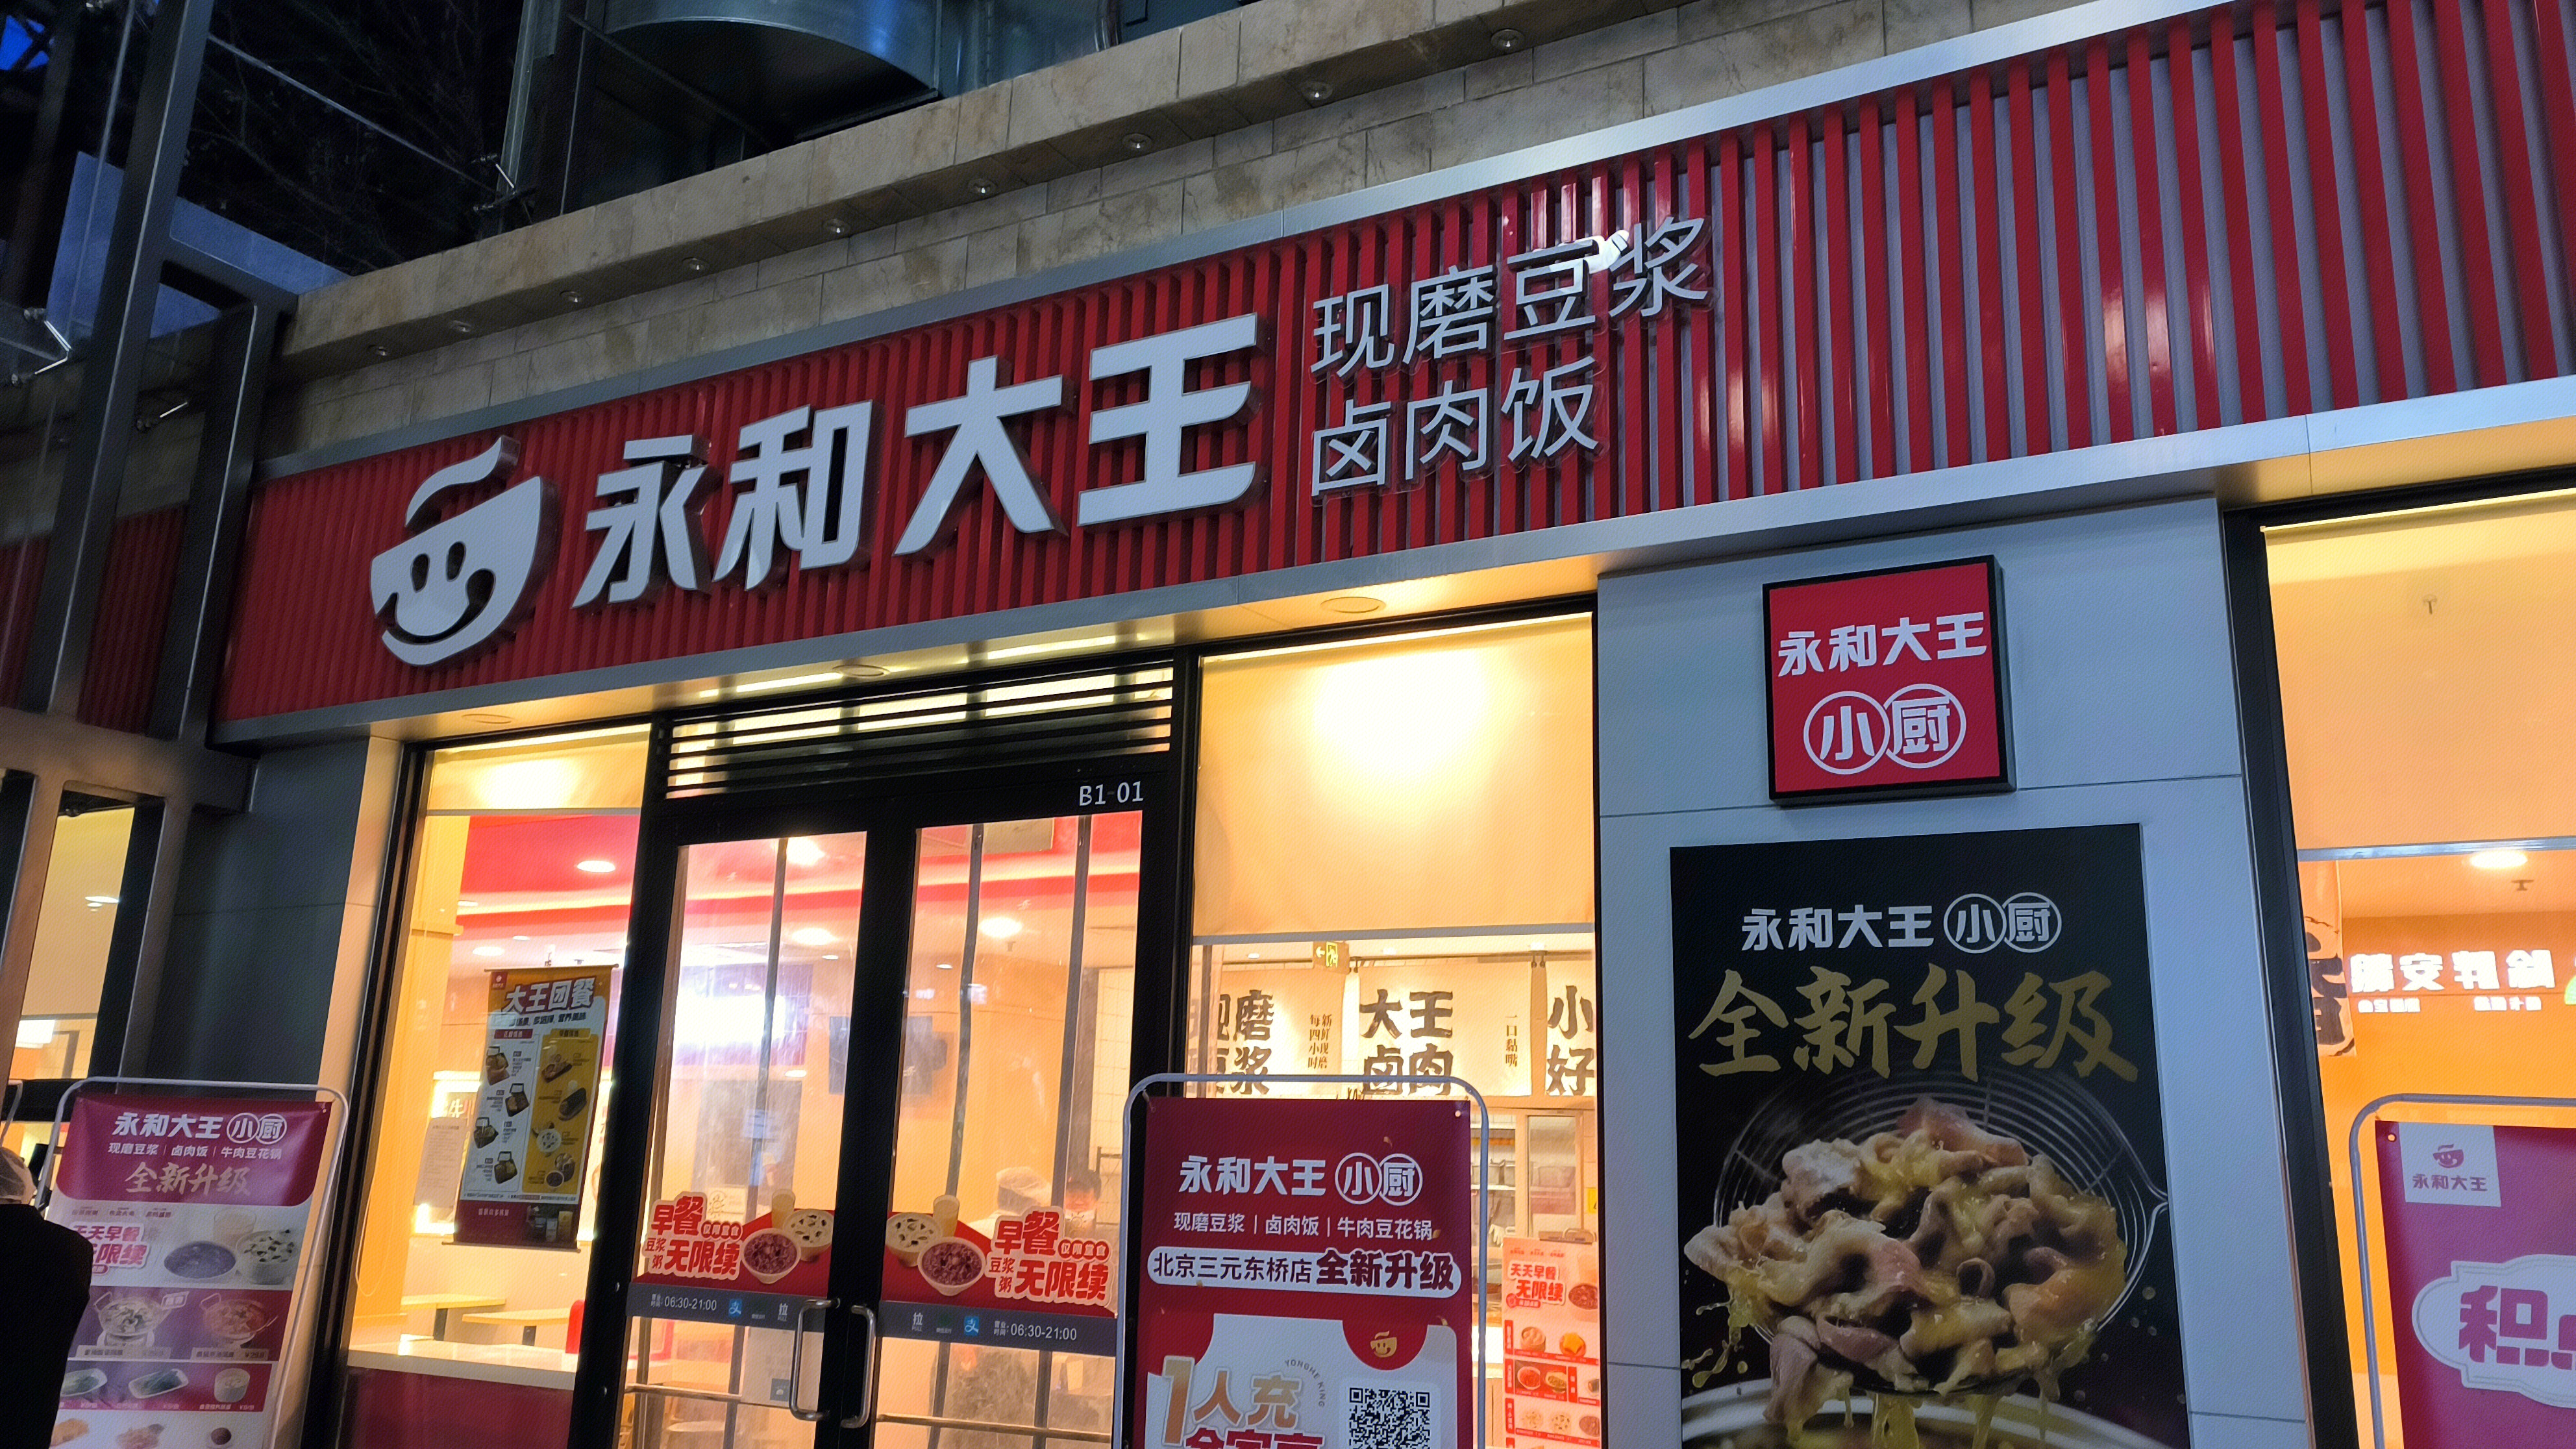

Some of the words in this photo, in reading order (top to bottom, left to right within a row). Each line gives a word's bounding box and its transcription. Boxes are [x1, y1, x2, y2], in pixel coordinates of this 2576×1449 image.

[1310, 216, 1708, 378] 现磨豆浆
[1311, 356, 1599, 497] 卤肉饭
[572, 313, 1258, 608] 永和大王
[1777, 612, 1987, 677] 永和大王
[1814, 691, 1954, 765] 小厨
[502, 977, 596, 1013] 大王团餐
[1359, 989, 1454, 1039] 大王
[1689, 963, 2139, 1083] 全新升级
[1363, 1043, 1454, 1096] 卤肉
[108, 1143, 160, 1156] 现磨豆浆
[171, 1146, 208, 1158] 卤肉饭
[221, 1146, 282, 1160] 牛肉豆花锅
[124, 1161, 251, 1196] 全新升级
[2412, 1173, 2488, 1193] 永和大王
[651, 1196, 704, 1236] 早餐
[995, 1211, 1059, 1256] 早餐
[1174, 1212, 1245, 1233] 现磨豆浆
[1265, 1215, 1319, 1236] 卤肉饭
[1337, 1217, 1432, 1241] 牛肉豆花锅
[93, 1243, 148, 1265] 限续
[663, 1239, 741, 1276] 无限续
[989, 1257, 1015, 1274] 豆浆
[1014, 1259, 1109, 1300] 无限续
[1516, 1280, 1564, 1302] 无限续
[664, 1296, 717, 1311] 06:30-21:00
[778, 1303, 789, 1316] 拉
[913, 1312, 923, 1326] 拉
[1010, 1323, 1077, 1341] 06:30-21:00
[1317, 1381, 1326, 1407] KING
